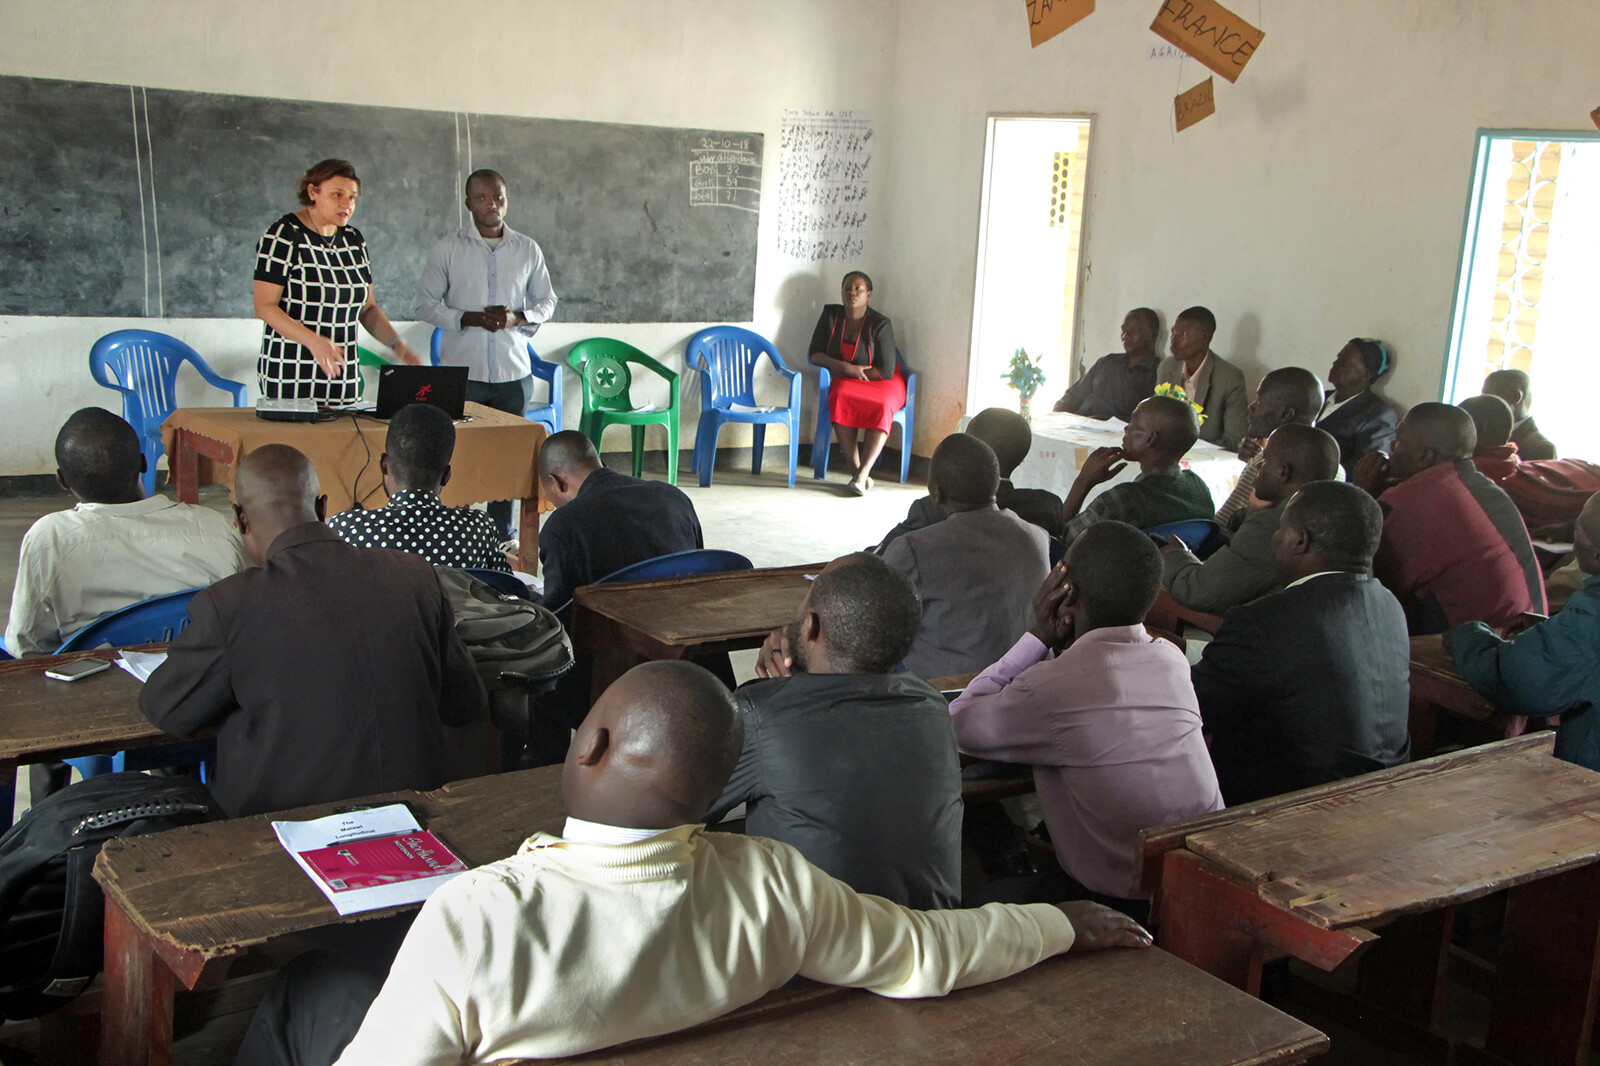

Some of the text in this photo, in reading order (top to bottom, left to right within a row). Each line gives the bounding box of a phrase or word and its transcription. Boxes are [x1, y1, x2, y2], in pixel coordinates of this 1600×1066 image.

[1159, 0, 1255, 66] FRANCE
[701, 138, 749, 150] 22-10-18
[726, 164, 740, 175] 32
[335, 829, 376, 839] Longitudinal
